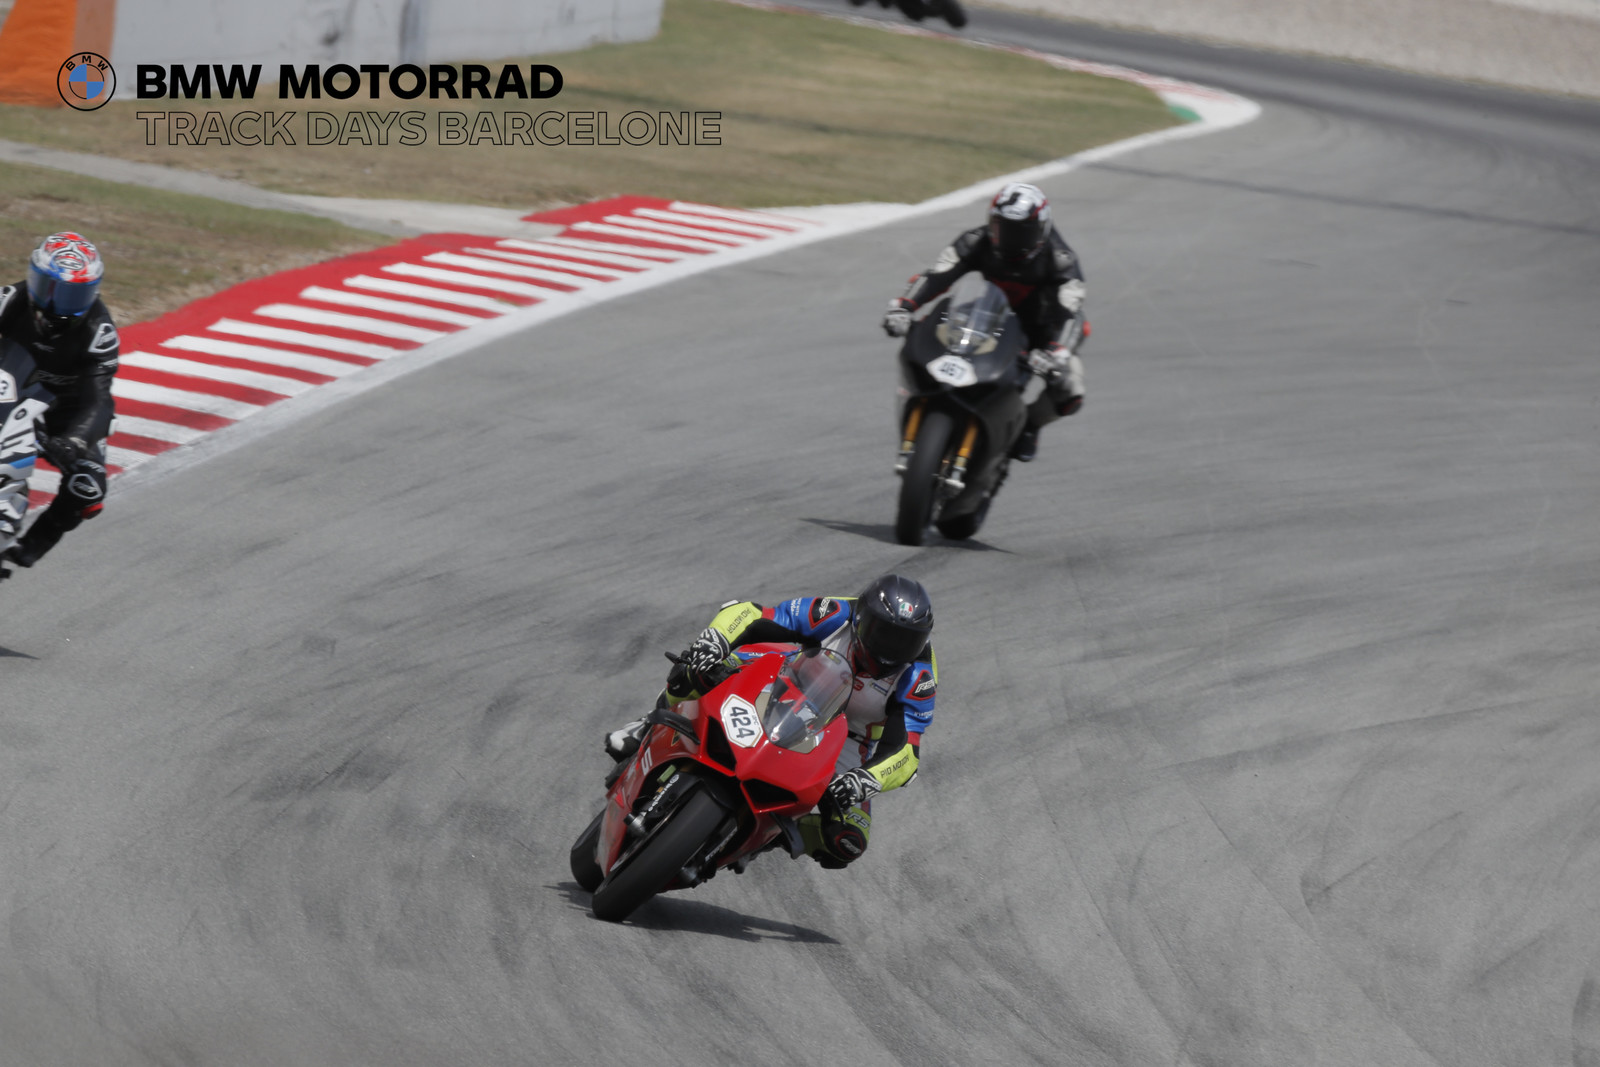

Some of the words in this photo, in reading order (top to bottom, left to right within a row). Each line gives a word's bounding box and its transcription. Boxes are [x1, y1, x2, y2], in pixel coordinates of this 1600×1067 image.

[730, 706, 756, 739] 424
[880, 766, 892, 779] PIO
[892, 755, 909, 772] MOTOR
